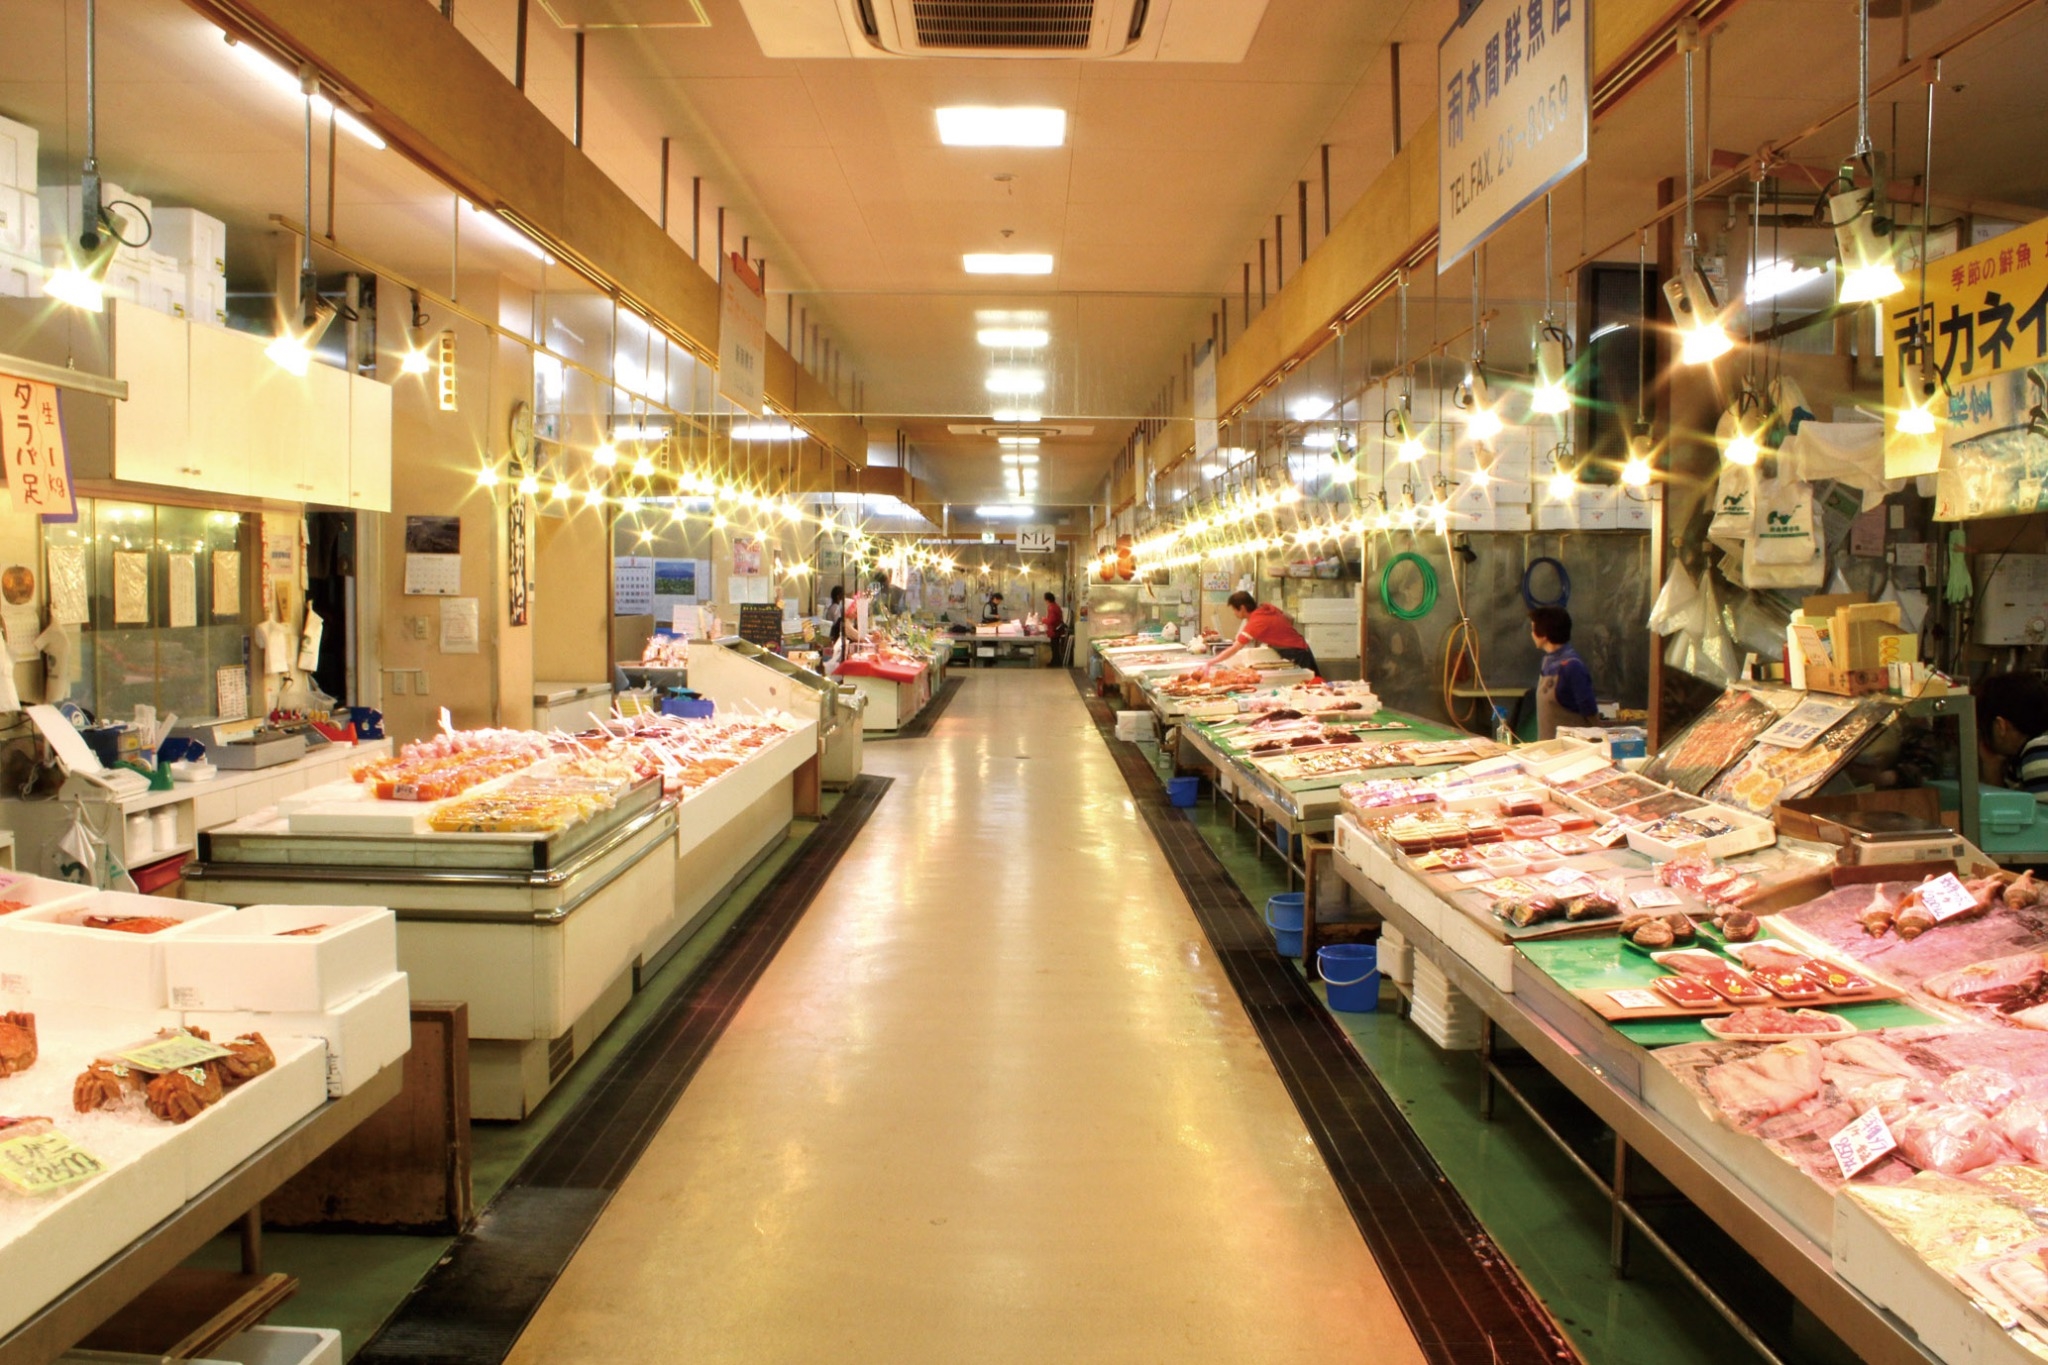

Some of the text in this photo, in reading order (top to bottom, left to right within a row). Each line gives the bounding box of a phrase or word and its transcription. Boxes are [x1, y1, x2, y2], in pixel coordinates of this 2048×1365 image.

[1951, 243, 2031, 292] 季節の鮮魚
[14, 383, 43, 505] タラバ足
[1021, 529, 1051, 545] トイレ
